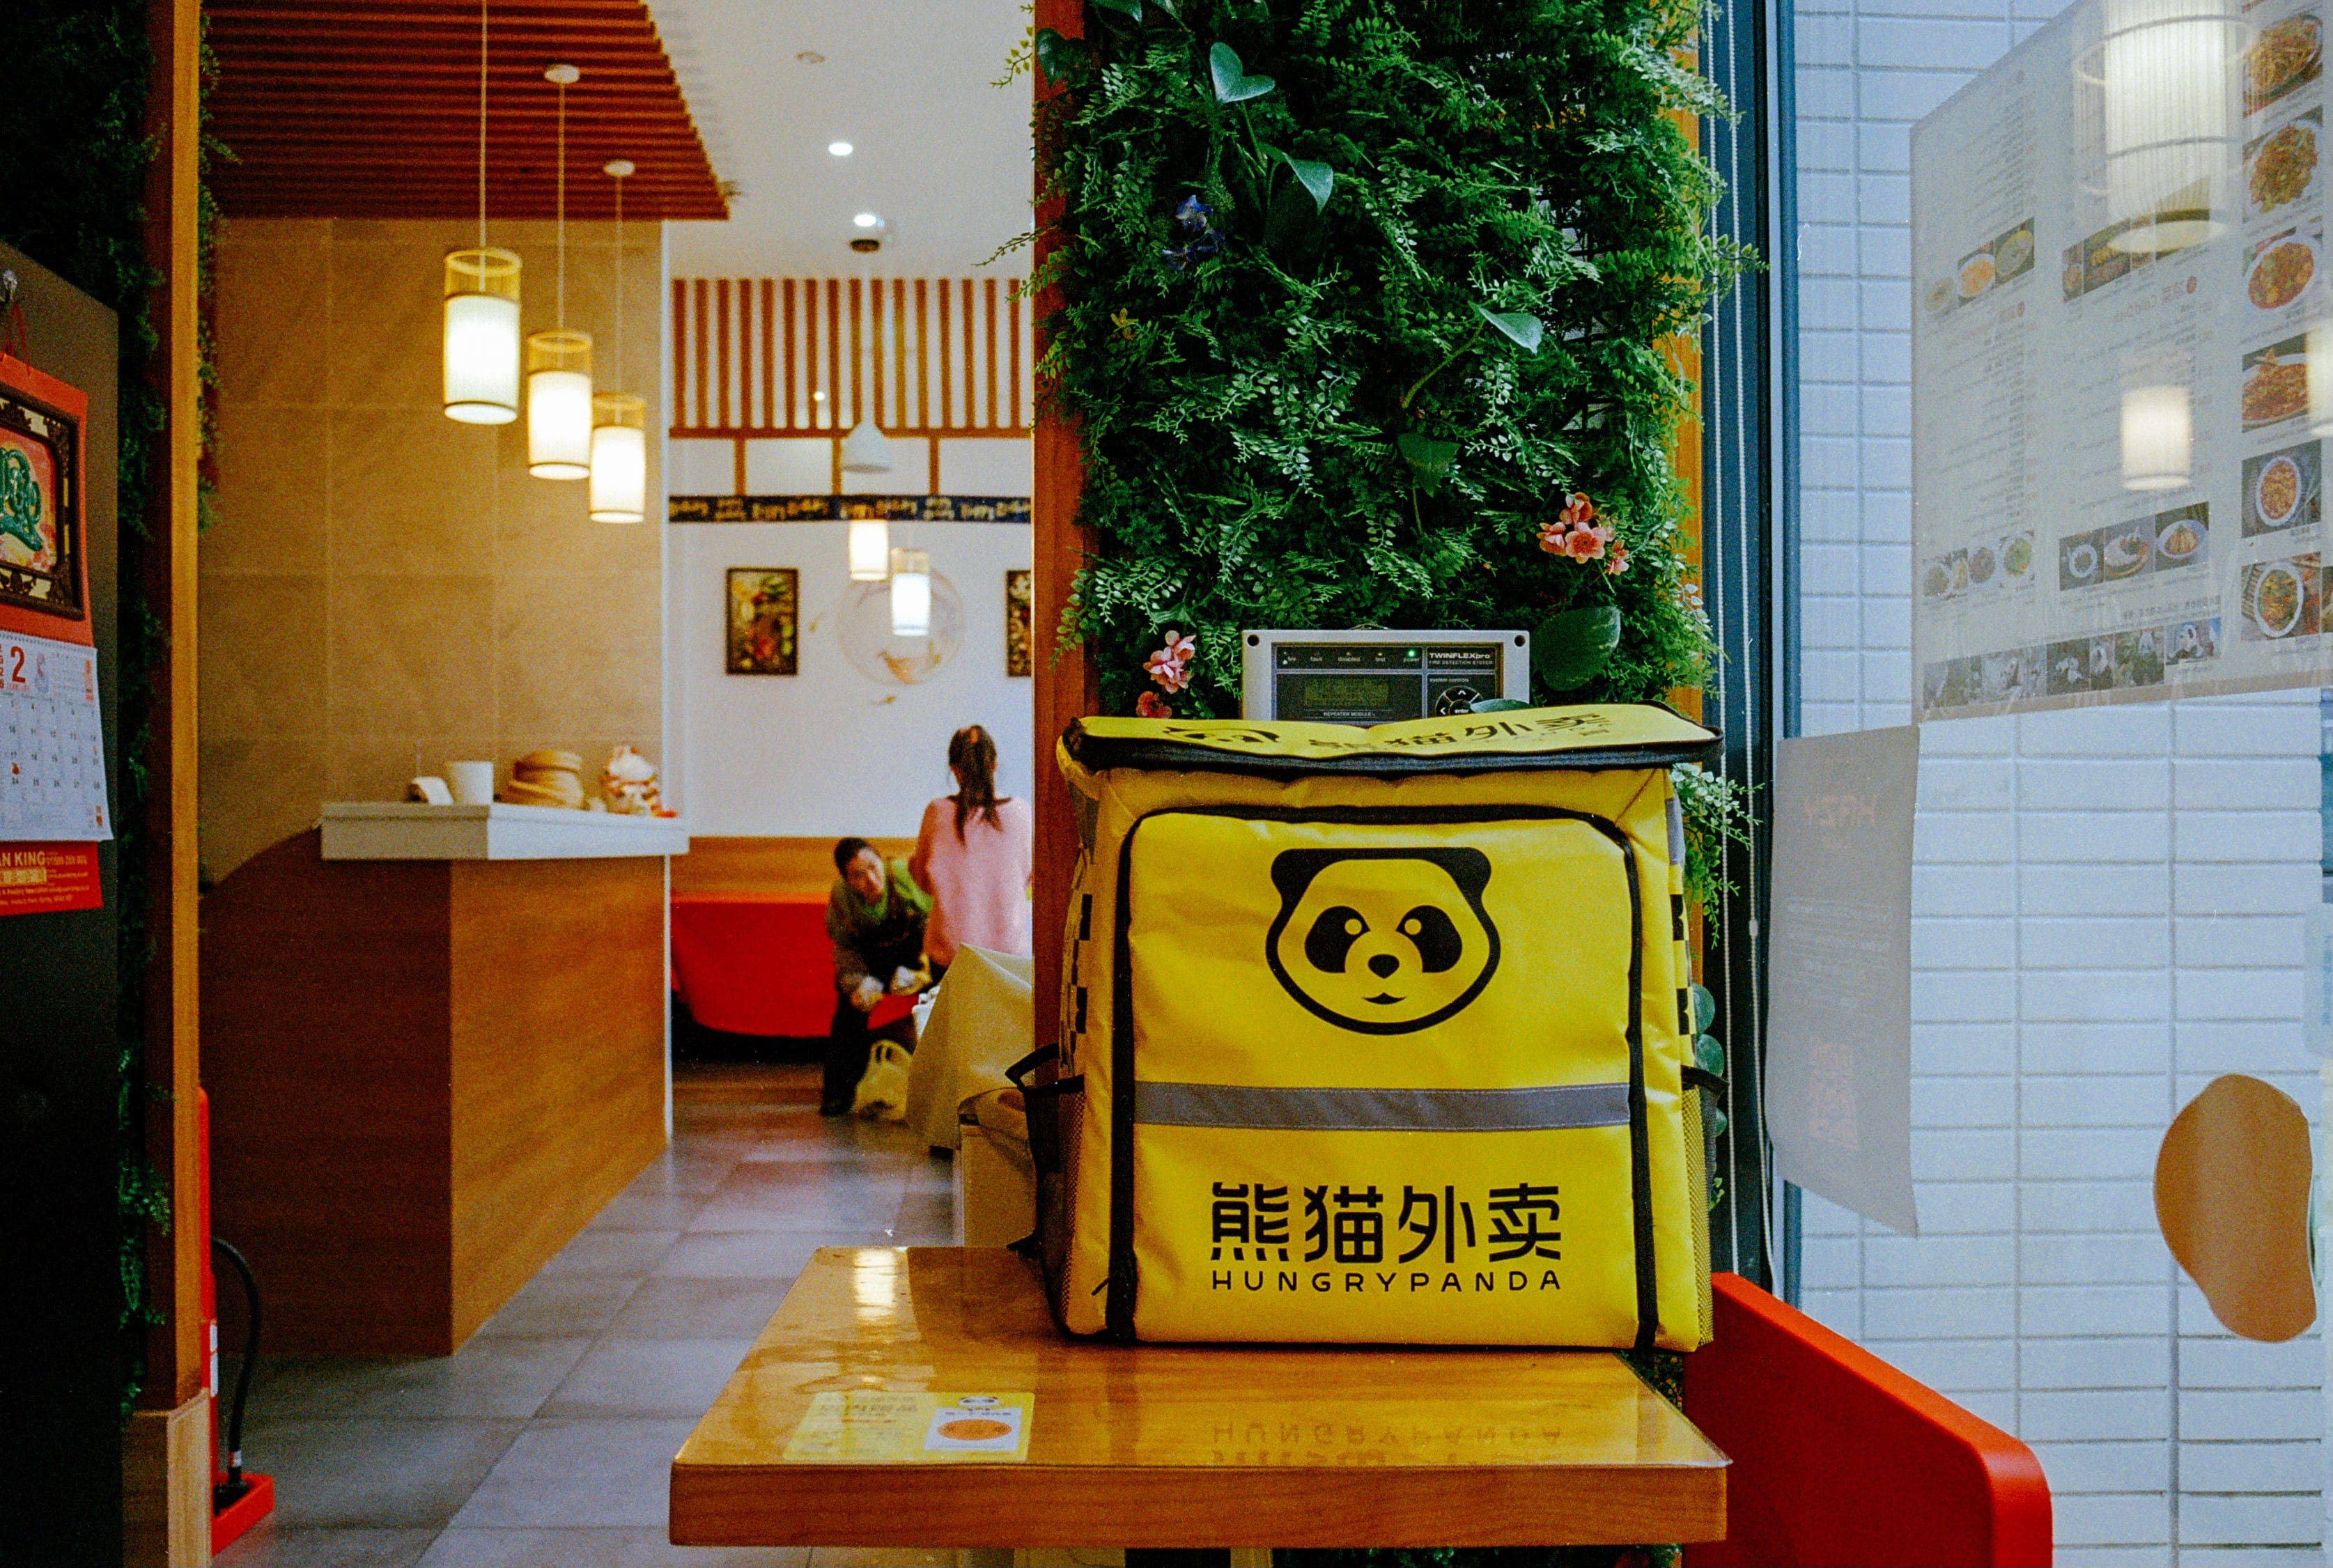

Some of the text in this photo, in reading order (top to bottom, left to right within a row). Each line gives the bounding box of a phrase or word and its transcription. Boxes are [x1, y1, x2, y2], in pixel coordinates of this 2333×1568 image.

[10, 646, 26, 683] 2
[0, 851, 11, 867] N
[14, 851, 45, 867] KING
[1211, 1182, 1561, 1264] 熊猫外卖
[1212, 1270, 1561, 1292] HUNGRYPANDA
